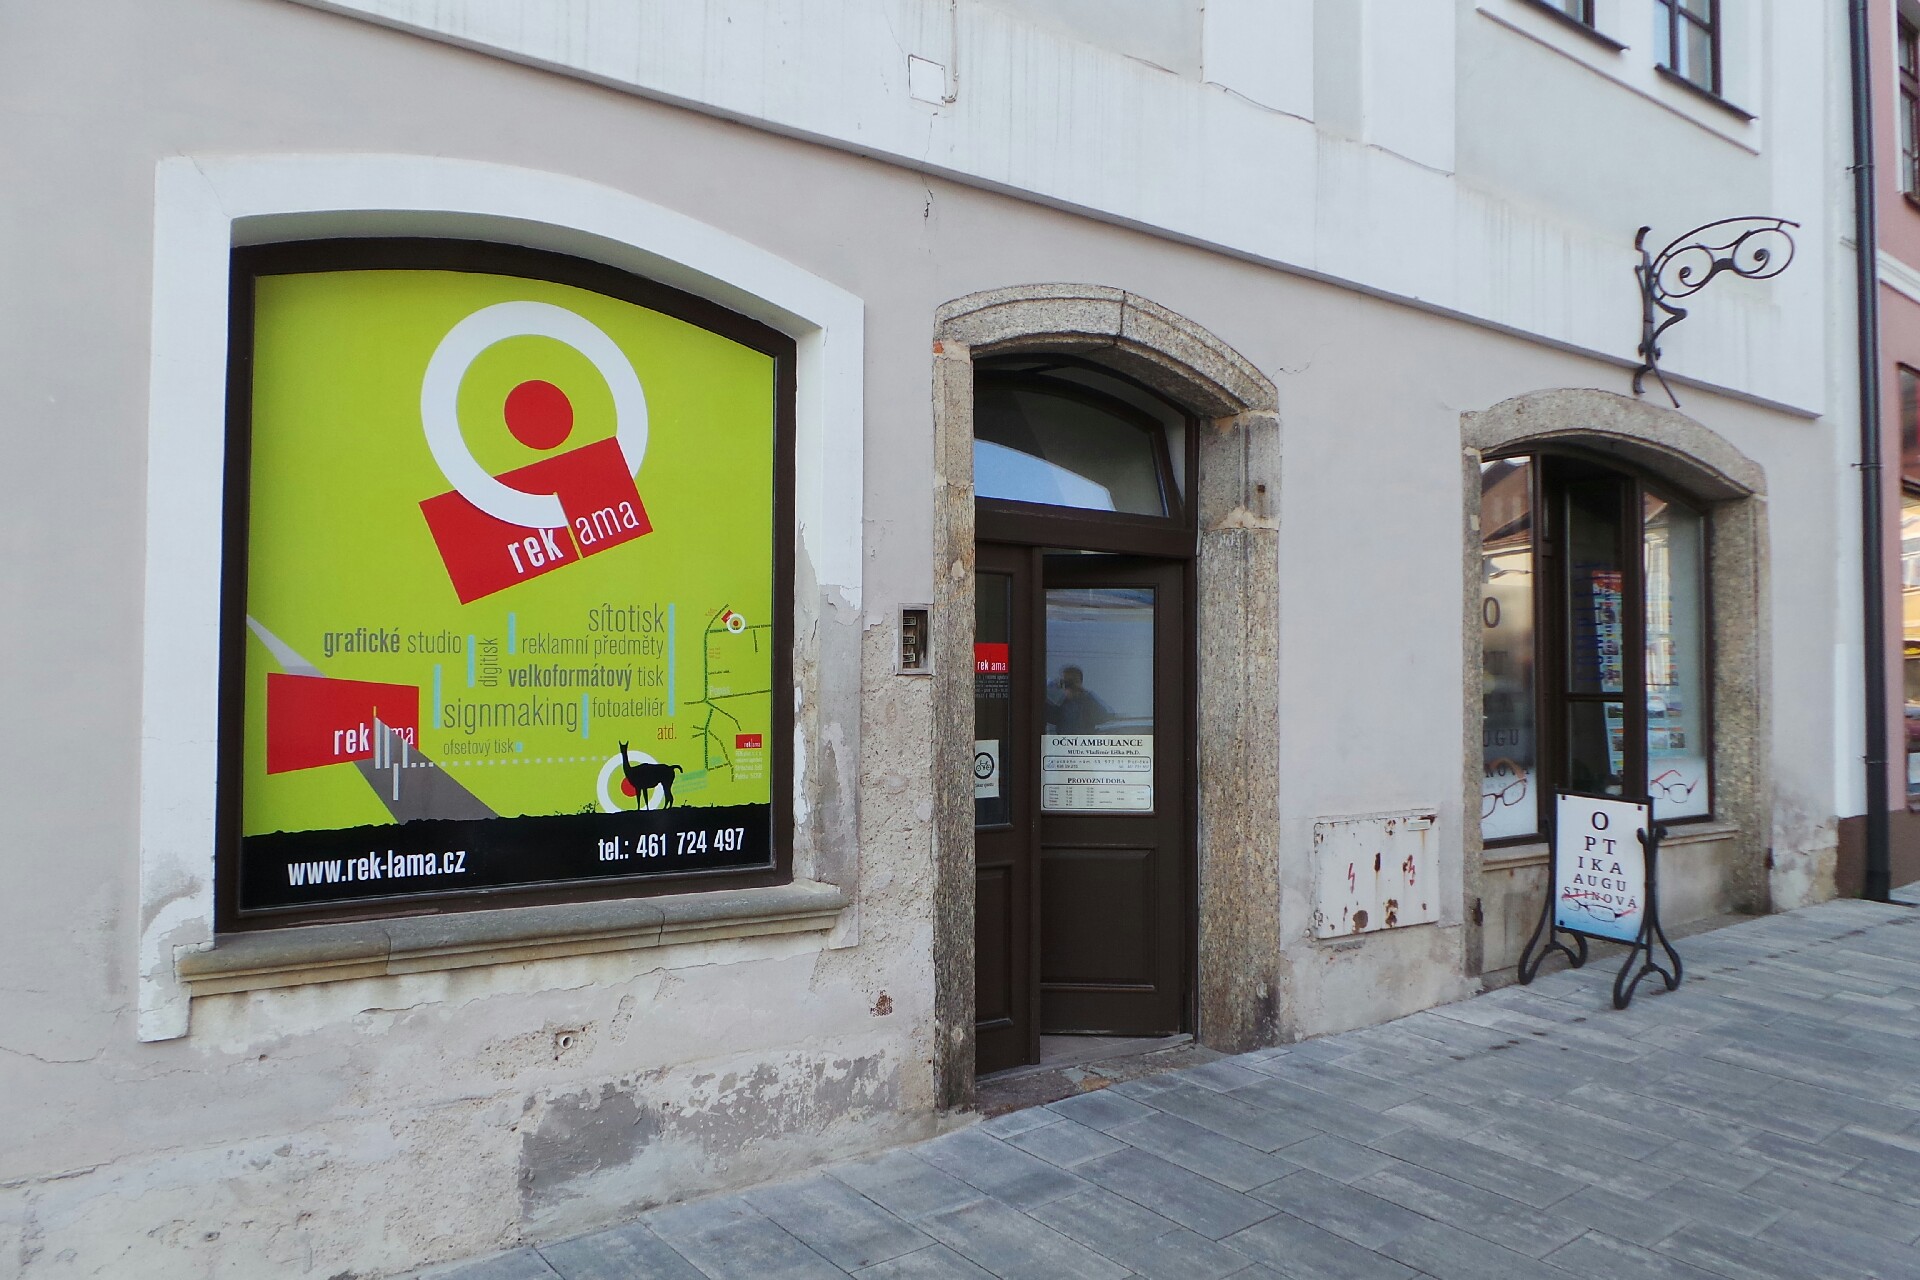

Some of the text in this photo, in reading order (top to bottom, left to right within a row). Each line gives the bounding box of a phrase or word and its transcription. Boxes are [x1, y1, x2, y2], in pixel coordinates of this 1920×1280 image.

[588, 602, 665, 633] sítotisk
[324, 627, 462, 657] grafické studio
[522, 632, 665, 660] reklamní předměty
[478, 637, 502, 688] digitisk
[508, 663, 665, 692] velkoformátový tisk
[443, 693, 578, 735] signmaking
[592, 697, 665, 718] fotoateliér
[443, 736, 514, 756] ofsetový tisk
[656, 722, 678, 741] atd.
[1051, 736, 1143, 747] OČNÍ AMBULANCE
[1591, 811, 1609, 831] O
[598, 827, 745, 862] tel.: 461 724 497
[287, 849, 467, 888] www.rek-lama.cz
